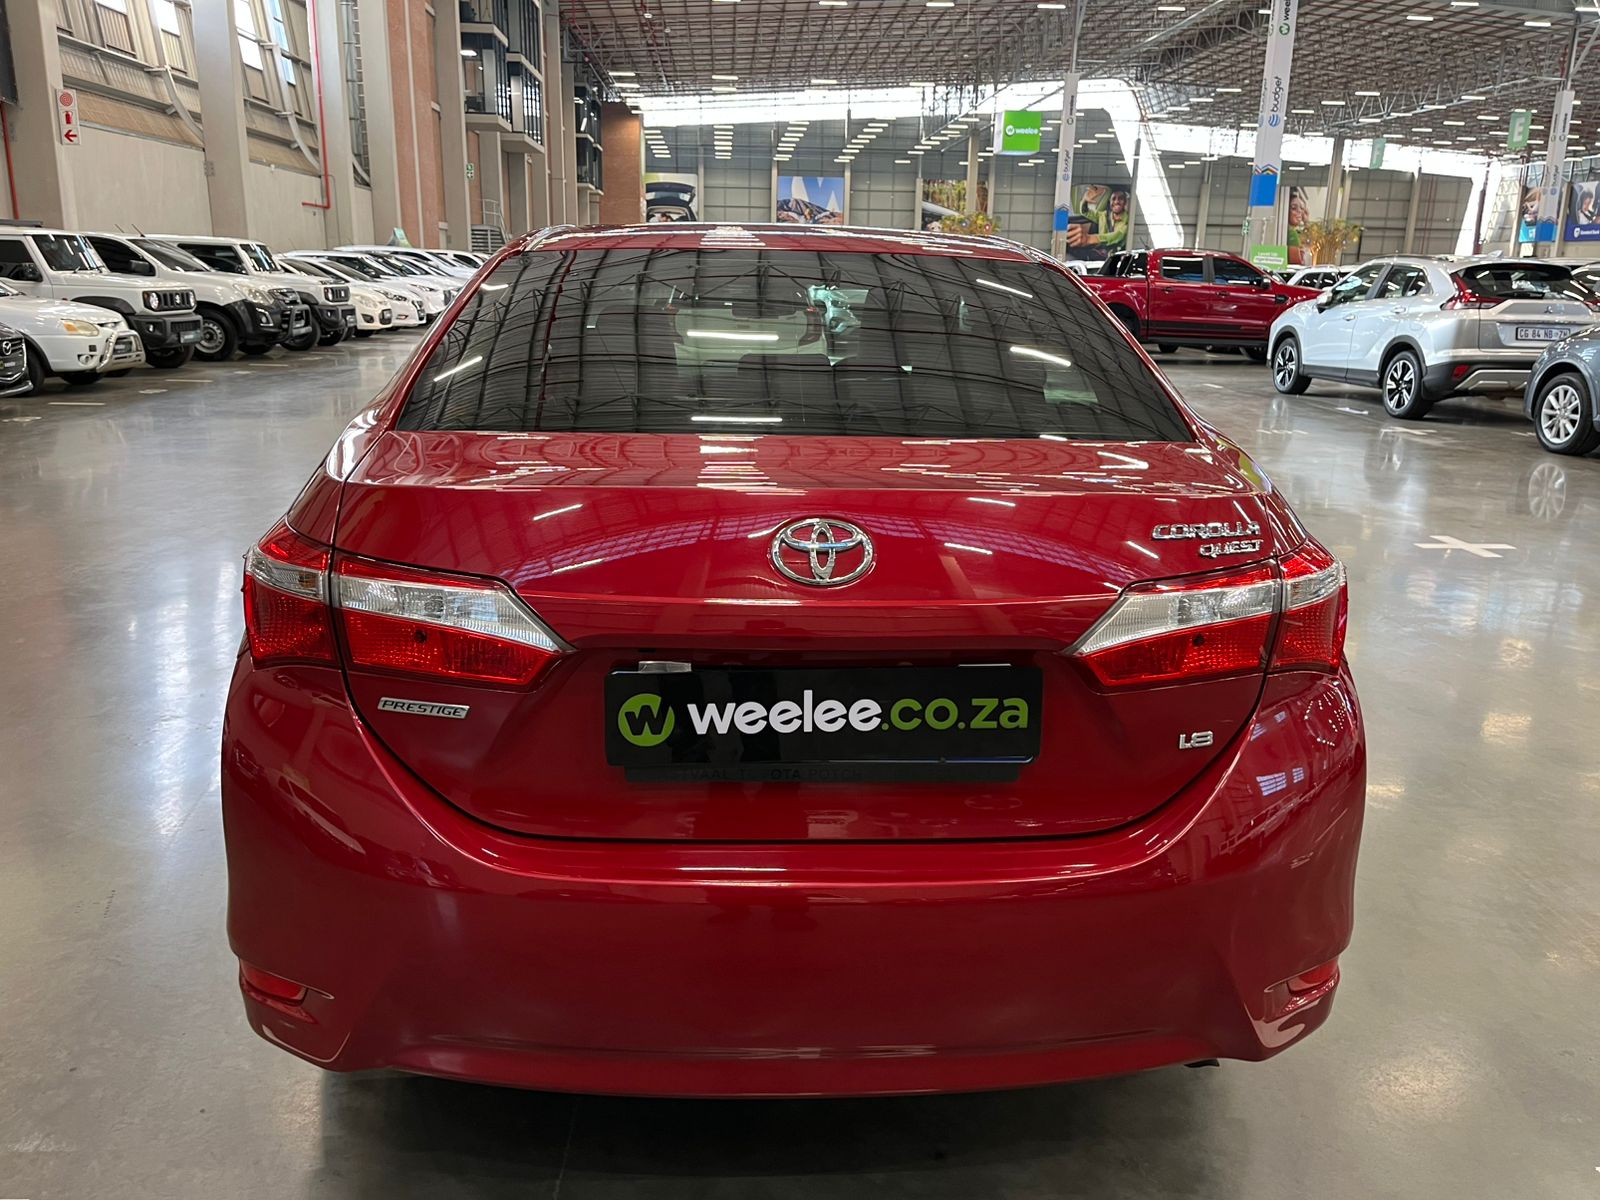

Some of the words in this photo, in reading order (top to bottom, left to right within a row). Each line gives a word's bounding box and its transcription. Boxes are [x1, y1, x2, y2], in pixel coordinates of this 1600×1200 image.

[1269, 76, 1284, 113] budget
[1512, 116, 1526, 143] E
[1531, 329, 1541, 339] 84
[1152, 521, 1260, 539] COROLLA
[1199, 540, 1264, 558] QUEST
[382, 700, 464, 717] PRESTIGE
[687, 689, 1029, 735] weelee.co.za
[1179, 731, 1213, 749] 1.8
